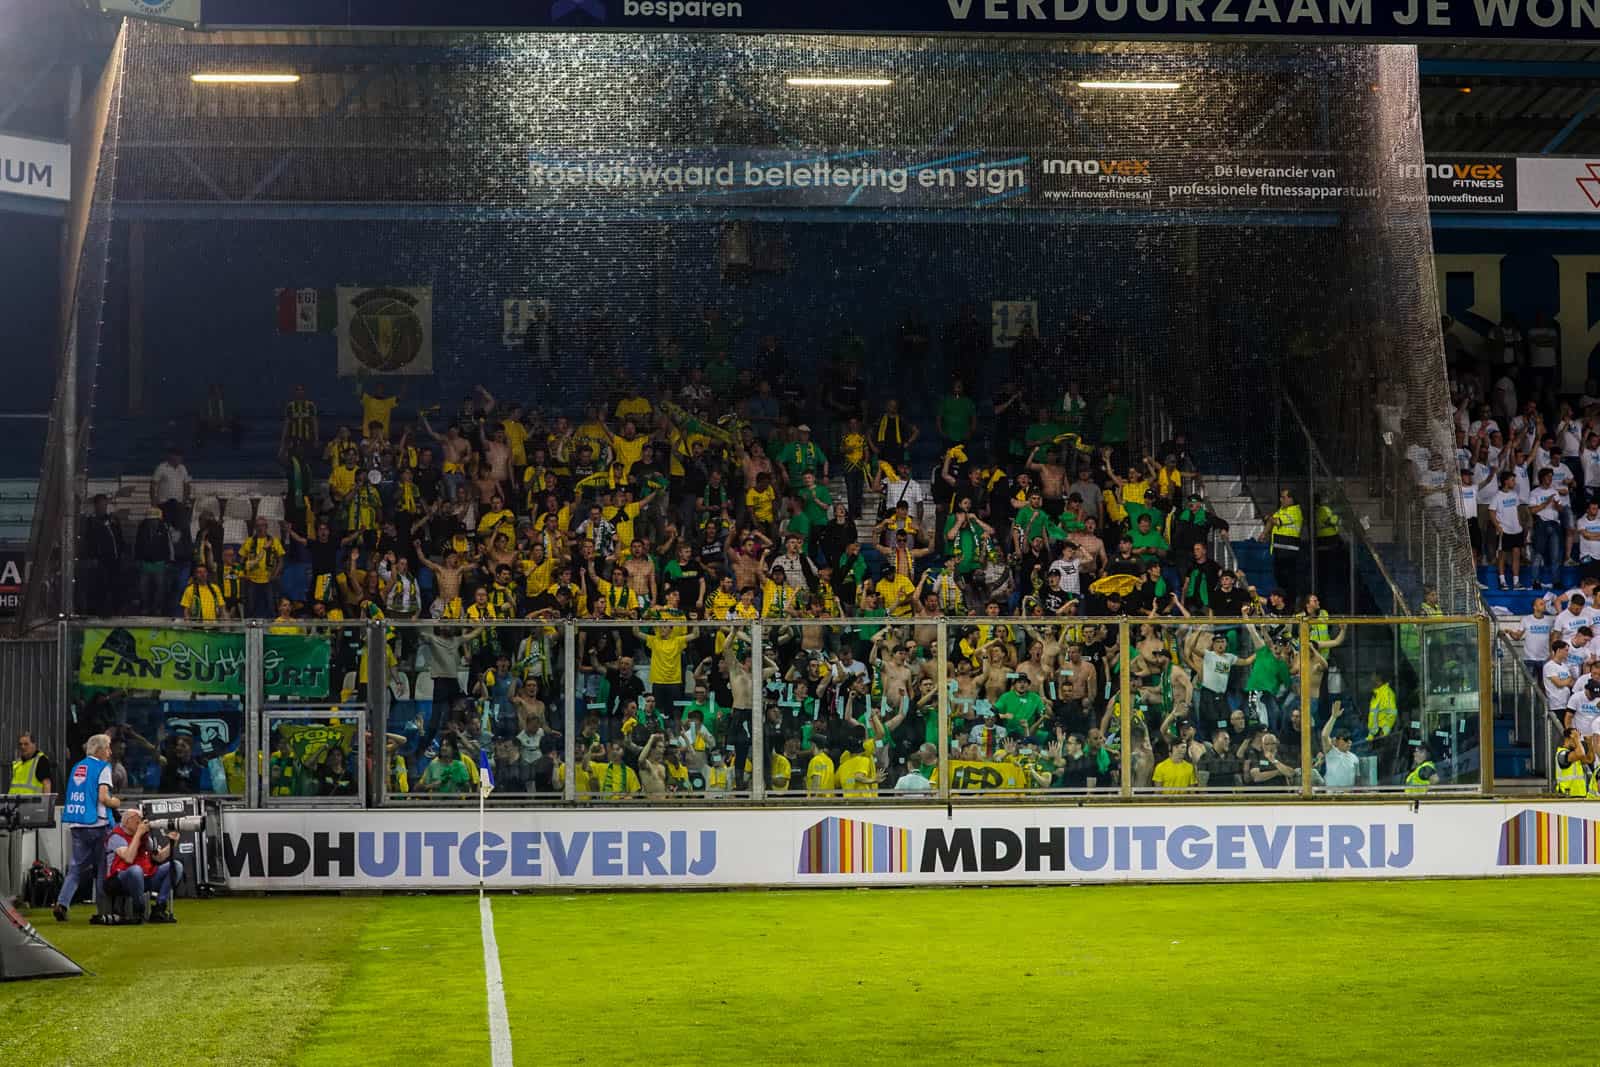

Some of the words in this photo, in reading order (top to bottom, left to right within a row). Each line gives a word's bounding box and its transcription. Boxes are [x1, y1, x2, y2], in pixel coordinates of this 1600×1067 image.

[624, 0, 742, 23] besparen
[947, 0, 1372, 25] VERDUURZAAM
[1392, 0, 1451, 26] JE
[0, 158, 52, 188] UM
[745, 161, 907, 193] belettering
[918, 167, 955, 188] en
[965, 162, 1025, 194] sign
[1098, 175, 1152, 184] FITNESS
[1236, 164, 1308, 178] leverancier
[1311, 168, 1336, 179] van
[1044, 189, 1152, 200] www.innovexfitness.nl
[1168, 182, 1258, 201] professionele
[1452, 179, 1505, 188] FITNESS
[216, 647, 285, 671] HAG
[91, 655, 162, 679] FAN
[173, 660, 325, 689] SUPORT
